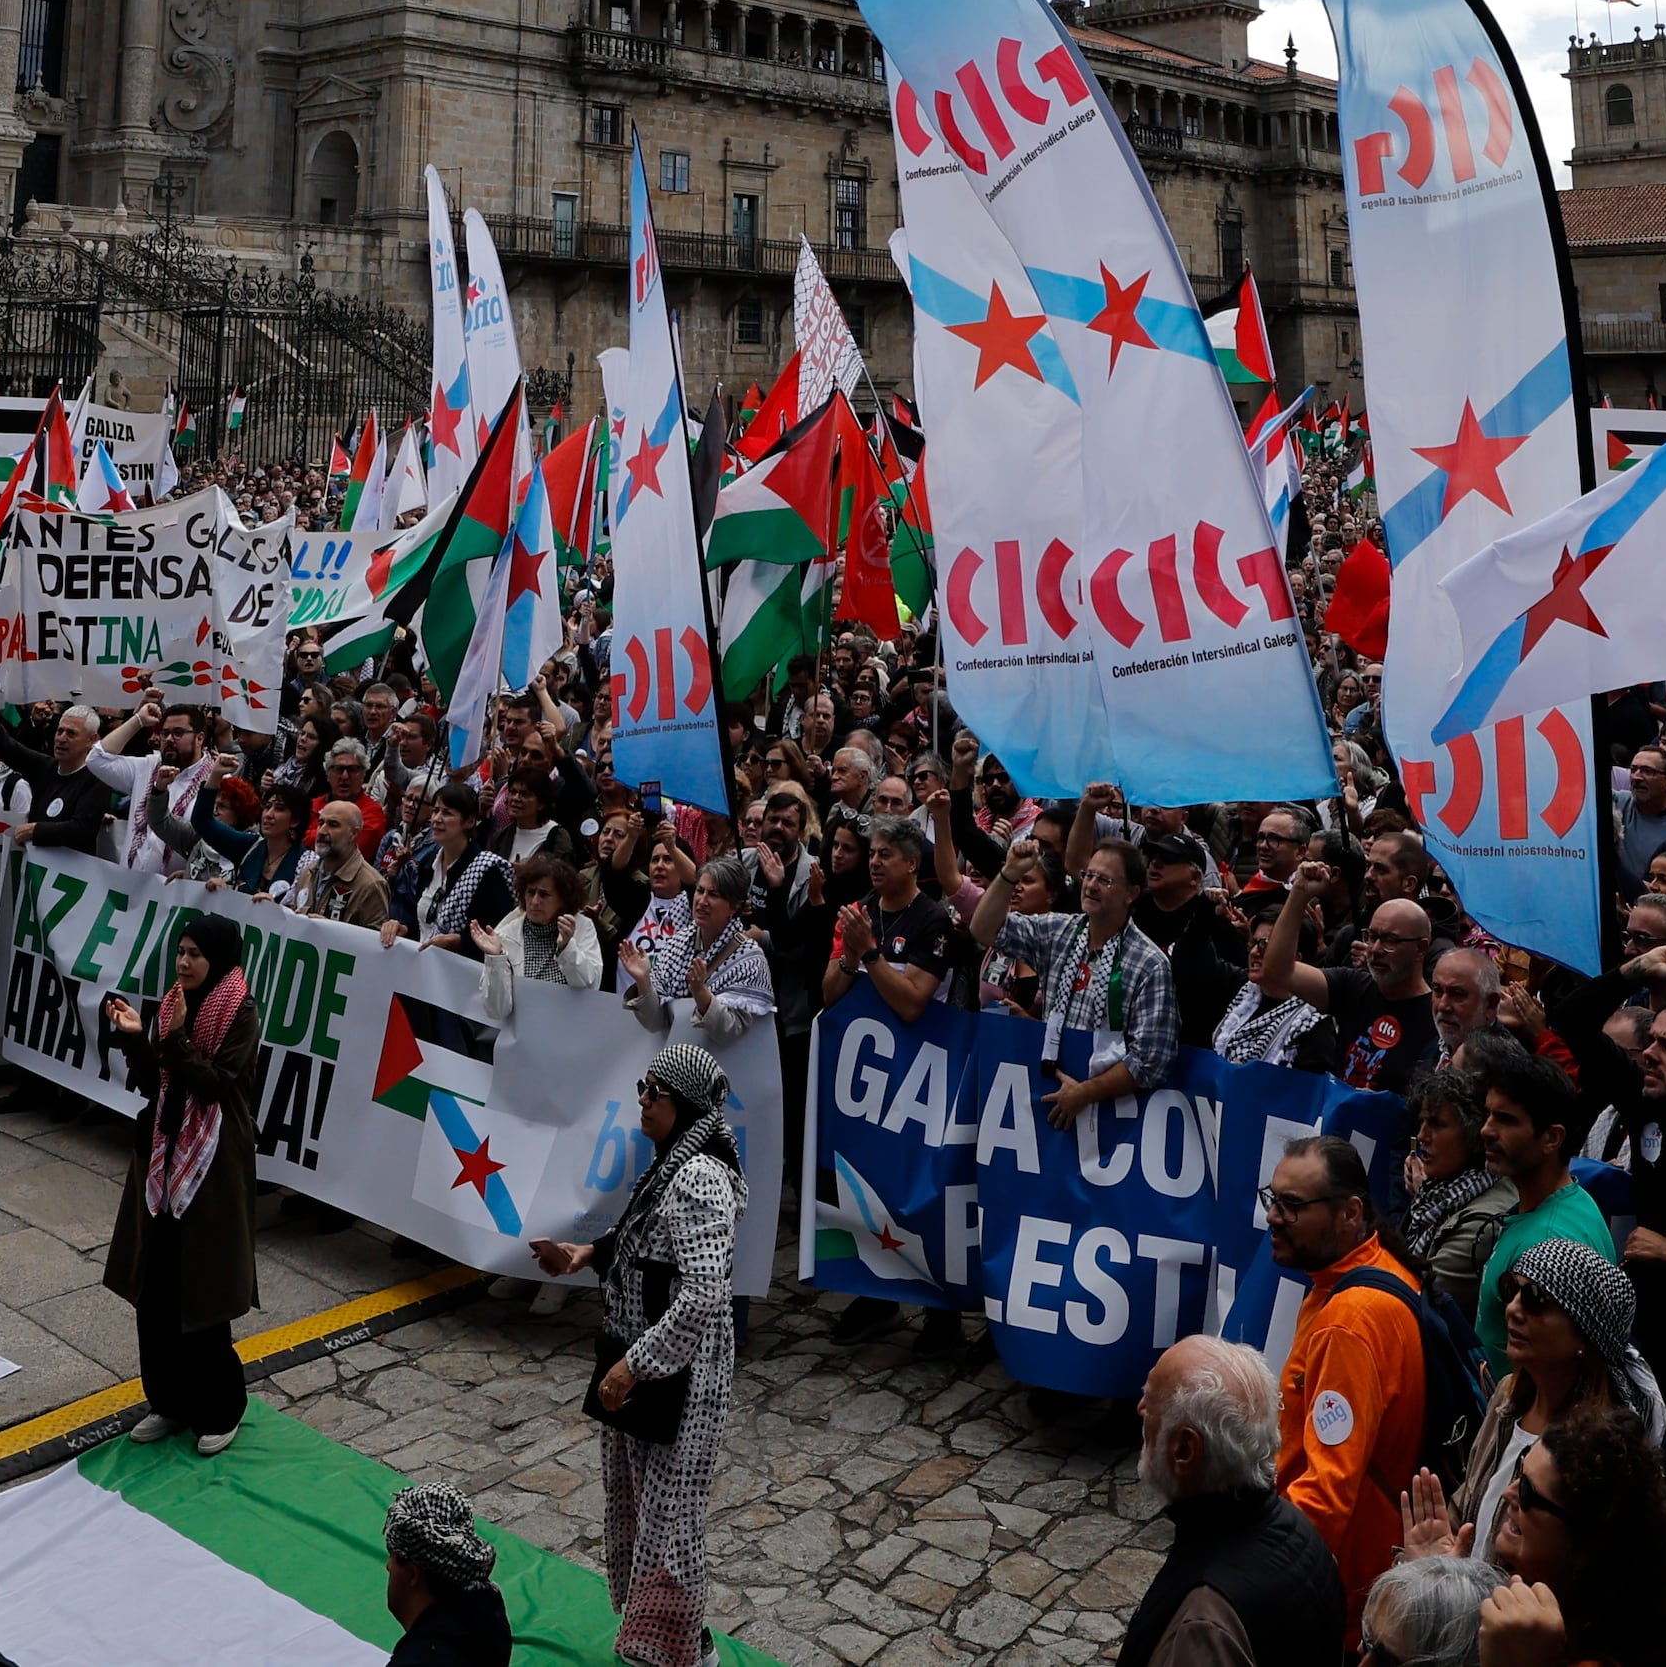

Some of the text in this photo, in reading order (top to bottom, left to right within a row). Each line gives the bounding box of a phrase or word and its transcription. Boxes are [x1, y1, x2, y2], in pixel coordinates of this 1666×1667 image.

[985, 108, 1097, 203] Confederación Intersindical Galega
[85, 416, 135, 442] GALIZA
[37, 554, 212, 600] DEFENSA
[1090, 519, 1295, 649] CIG
[227, 582, 274, 627] DE
[956, 654, 1023, 672] Confederación
[1026, 650, 1080, 665] Intersindical
[1112, 632, 1298, 679] Confederación Intersindical Galega
[71, 889, 129, 983] E
[324, 1326, 372, 1352] KACHET
[1317, 1404, 1347, 1432] bng
